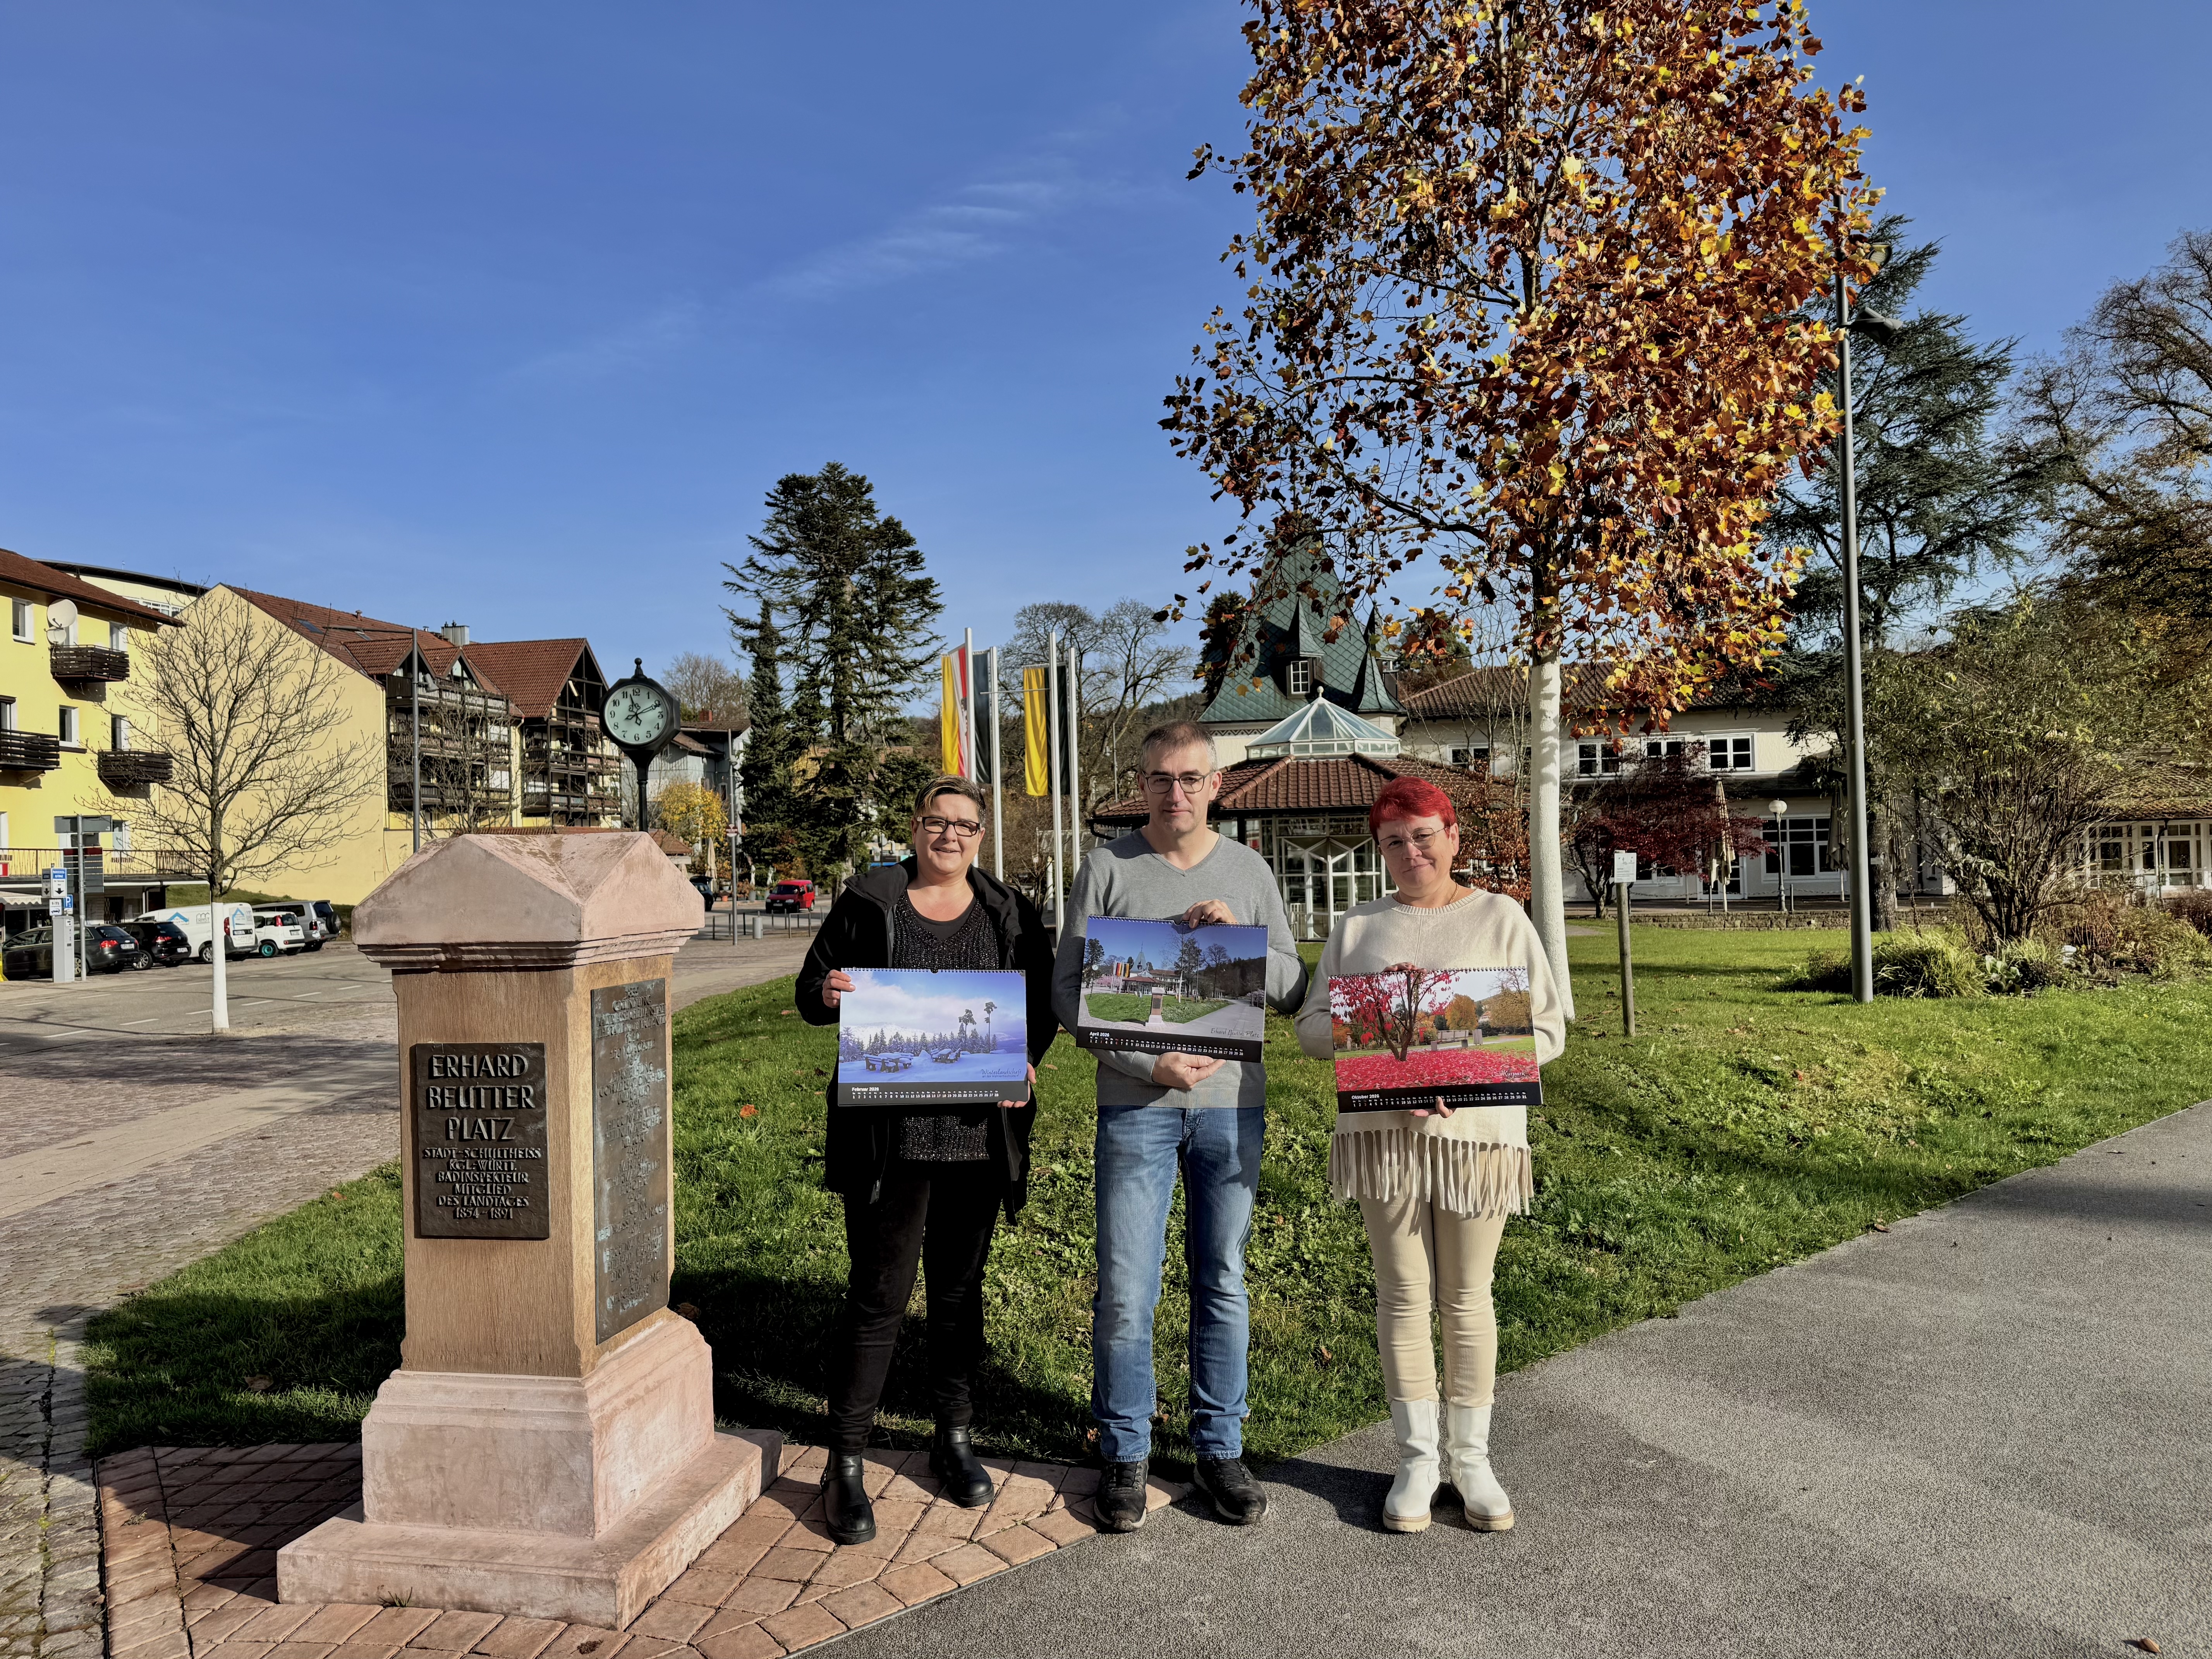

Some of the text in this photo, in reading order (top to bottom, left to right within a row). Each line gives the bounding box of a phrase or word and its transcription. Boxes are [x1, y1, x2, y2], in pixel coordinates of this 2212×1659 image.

[432, 1054, 529, 1077] ERHARD
[981, 1068, 1021, 1077] Winterlandschaft
[1503, 1069, 1525, 1079] Kurpark
[429, 1085, 536, 1108] BEUTTER
[448, 1117, 516, 1140] PLATZ
[438, 1171, 529, 1183] BADINSPEKTEUR
[455, 1183, 512, 1195] MITGLIED
[438, 1195, 529, 1207] DES LANDTAGES
